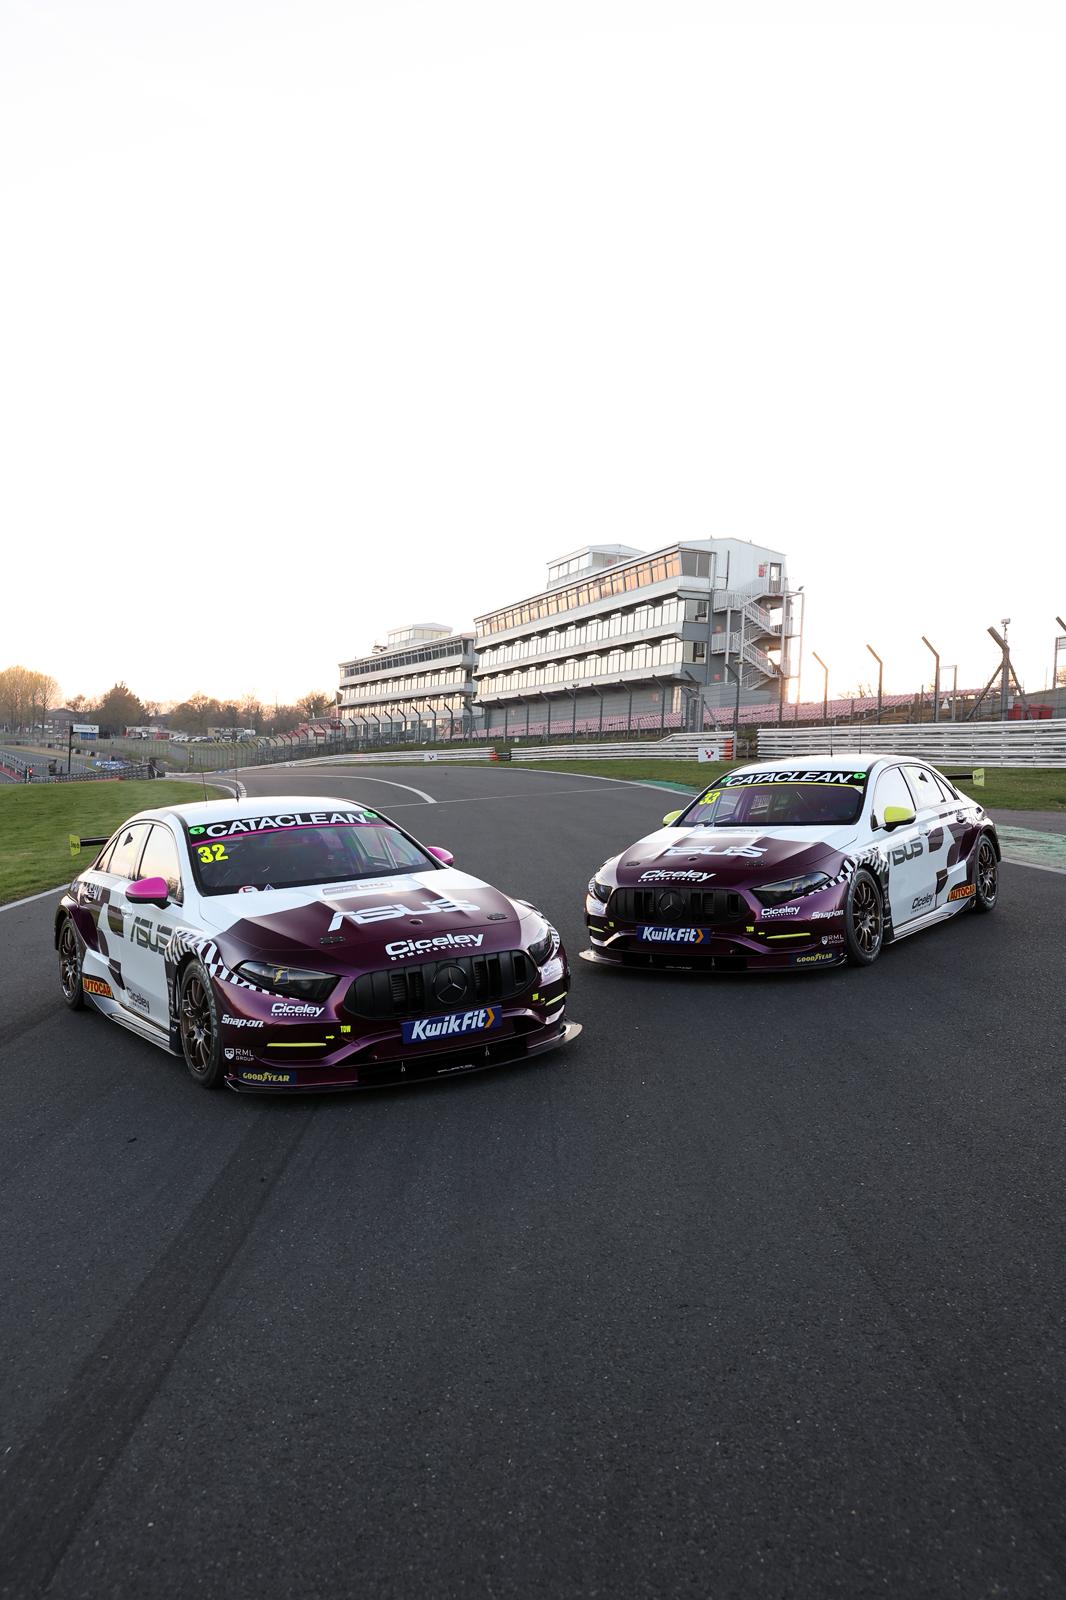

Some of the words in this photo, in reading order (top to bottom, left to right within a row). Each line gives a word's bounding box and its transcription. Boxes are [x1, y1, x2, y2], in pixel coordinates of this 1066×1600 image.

[726, 771, 852, 787] CATACLEAN
[699, 791, 721, 805] 33
[206, 813, 368, 837] CATACLEAN
[198, 844, 228, 863] 32
[664, 845, 768, 858] SUS
[640, 869, 717, 882] Ciceley
[327, 899, 481, 932] ASUS
[761, 906, 800, 917] Ciceley
[811, 909, 844, 920] Snap-on
[385, 933, 484, 956] Ciceley
[796, 953, 833, 963] GOODYEAR
[271, 1003, 325, 1017] Ciceley
[221, 1014, 264, 1028] Snap-on
[235, 1048, 254, 1057] RML
[242, 1071, 290, 1082] GOODYEAR
